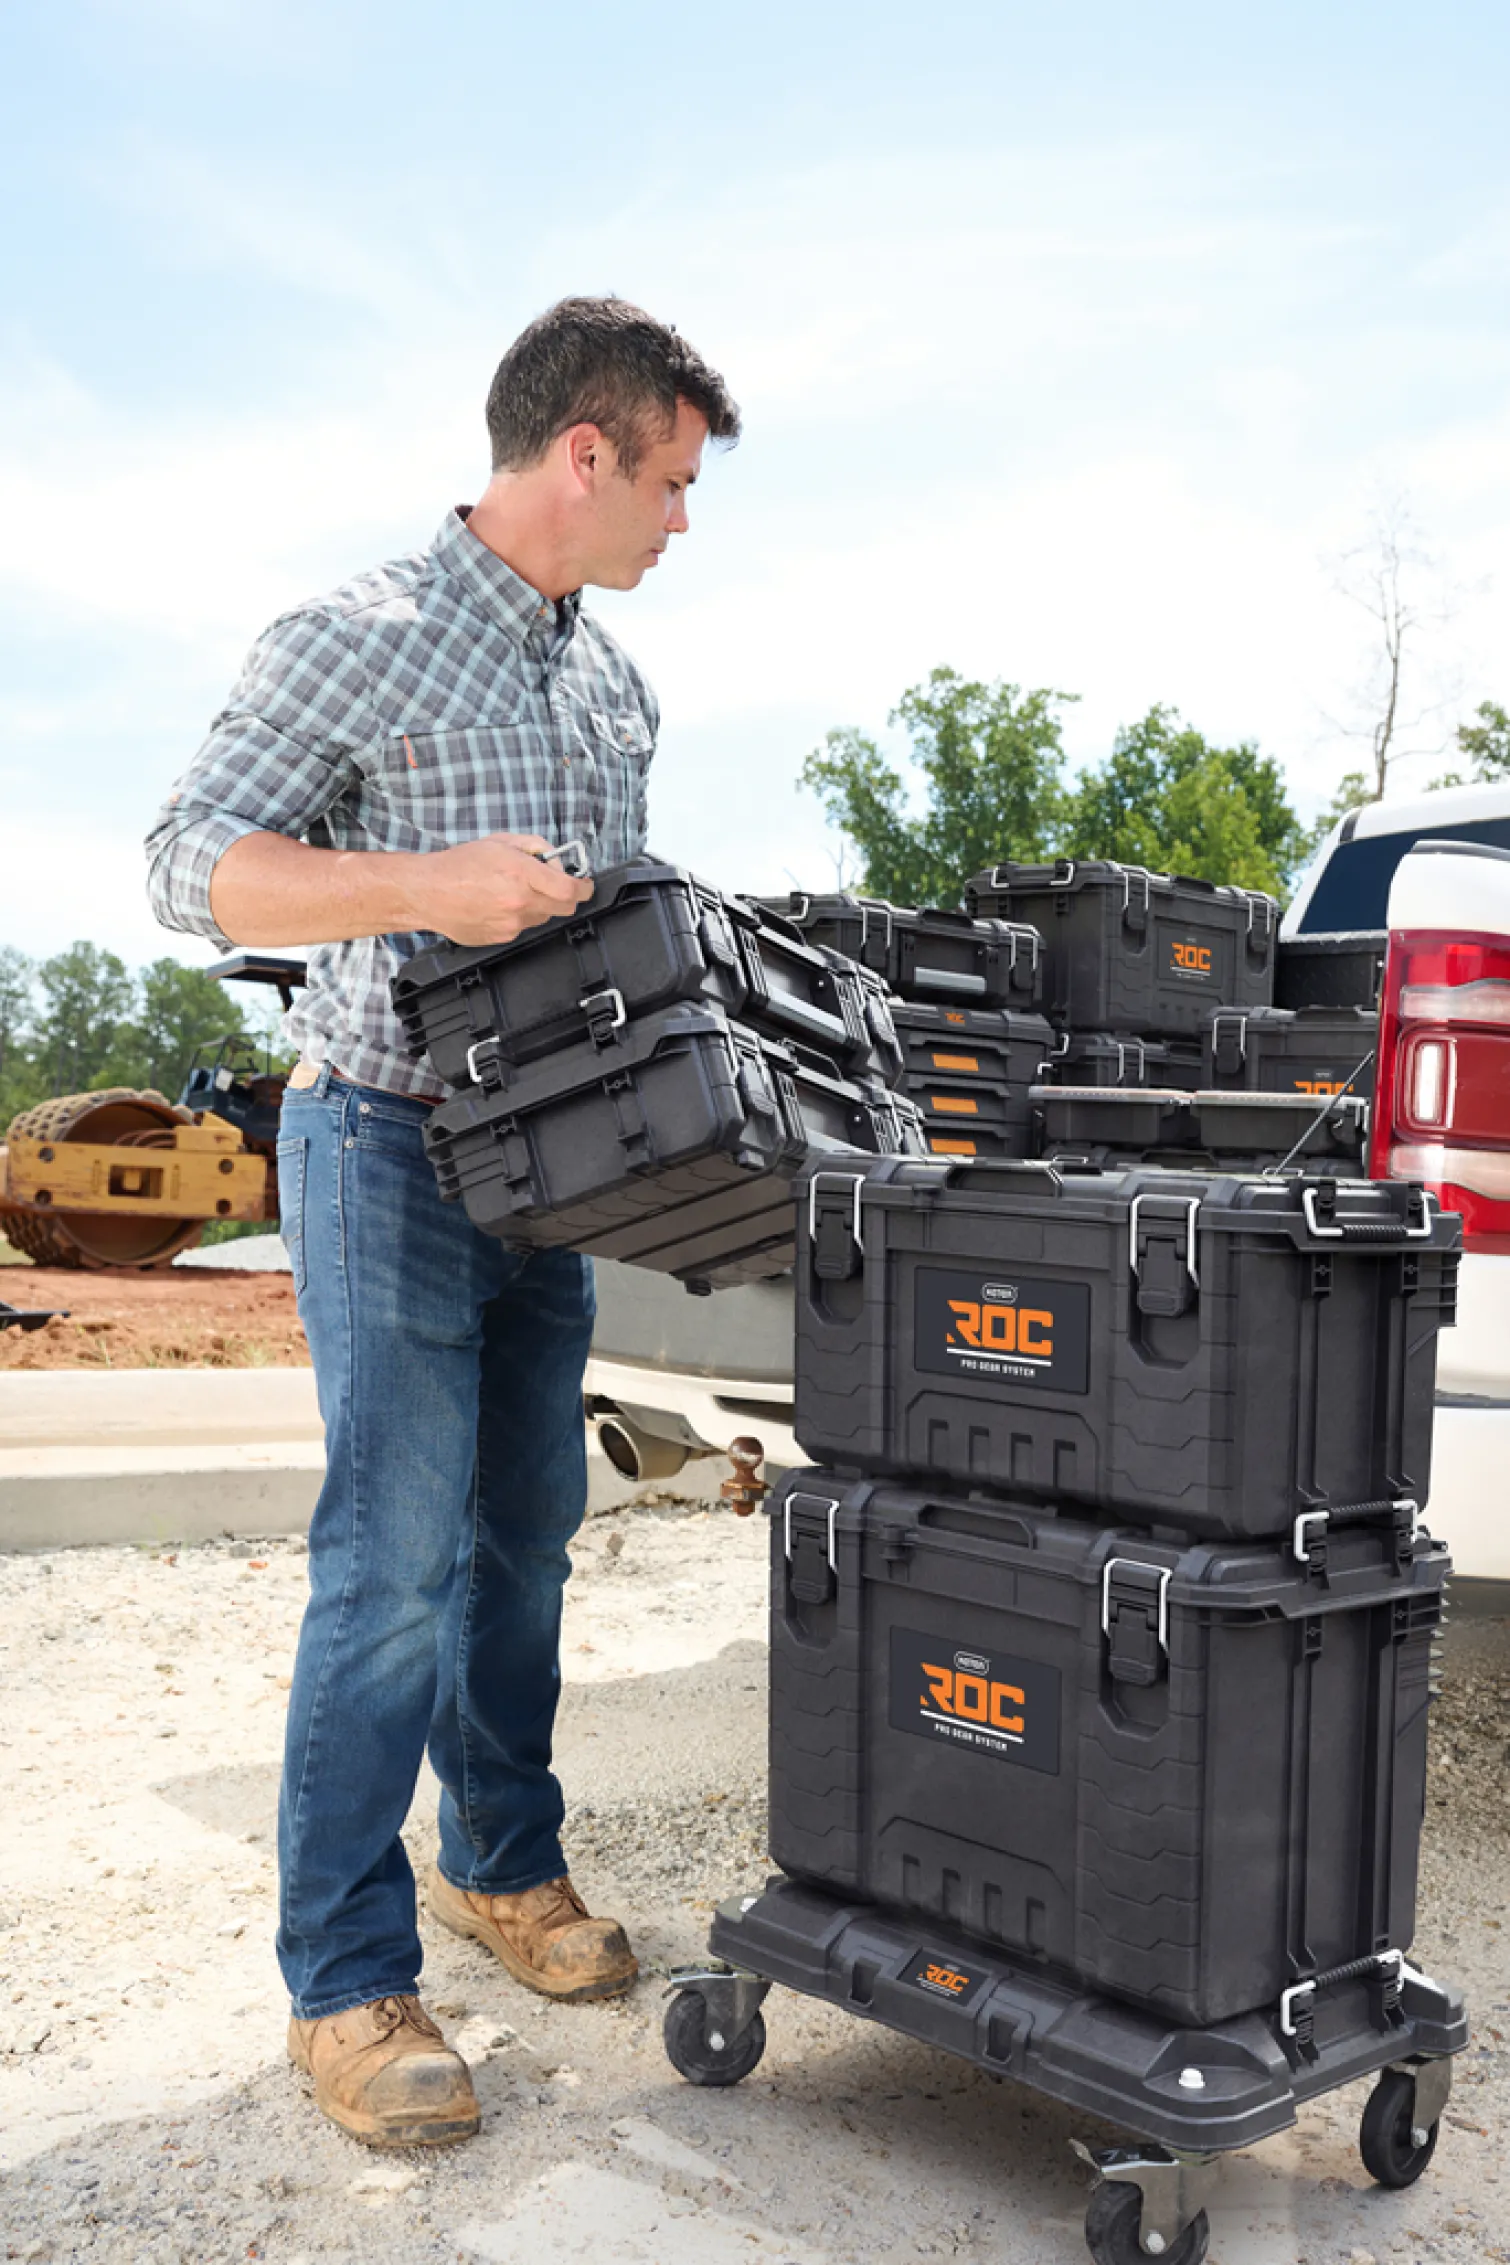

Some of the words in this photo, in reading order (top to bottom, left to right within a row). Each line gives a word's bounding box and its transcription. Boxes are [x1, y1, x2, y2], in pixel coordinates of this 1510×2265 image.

[1170, 942, 1212, 971] ROC
[946, 1300, 1053, 1356] ROC
[920, 1663, 1025, 1733] ROC
[919, 1963, 969, 1992] ROC
